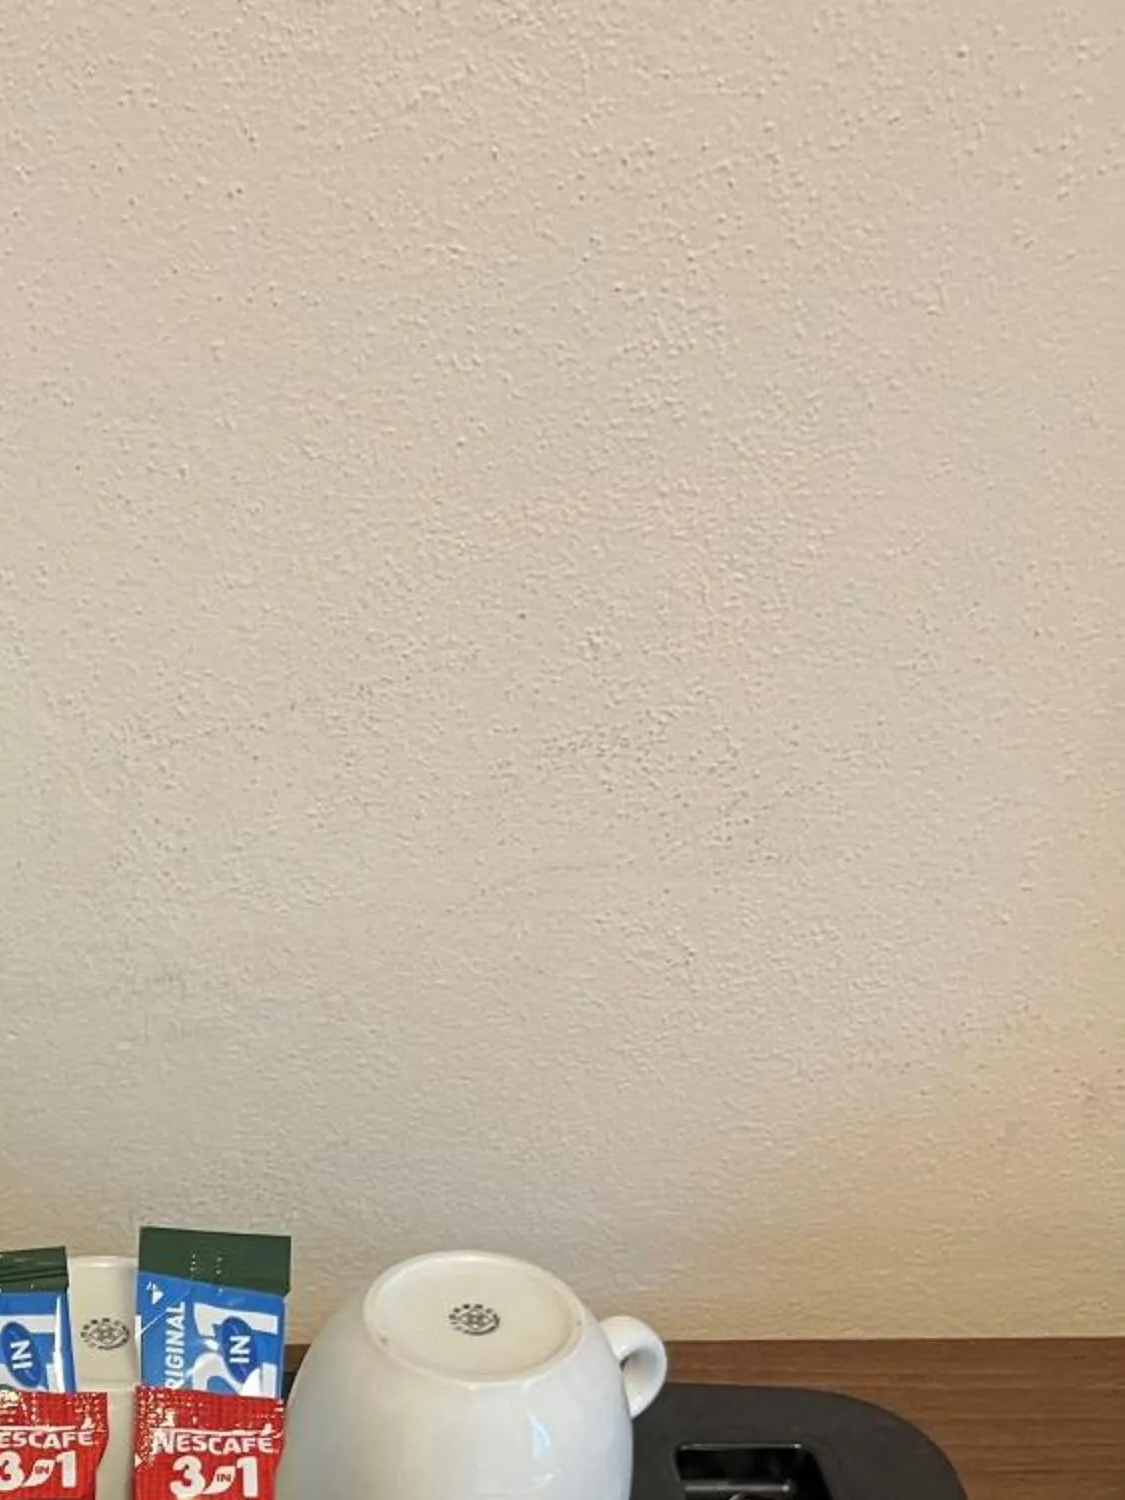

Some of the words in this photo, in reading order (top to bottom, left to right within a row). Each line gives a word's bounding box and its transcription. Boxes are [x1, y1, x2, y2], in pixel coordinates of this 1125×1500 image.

[10, 1339, 32, 1370] IN
[164, 1302, 185, 1388] RIGINAL
[229, 1335, 251, 1364] IN
[56, 1450, 76, 1488] 1
[170, 1456, 205, 1500] 3
[216, 1473, 232, 1483] IN
[236, 1456, 259, 1498] 1
